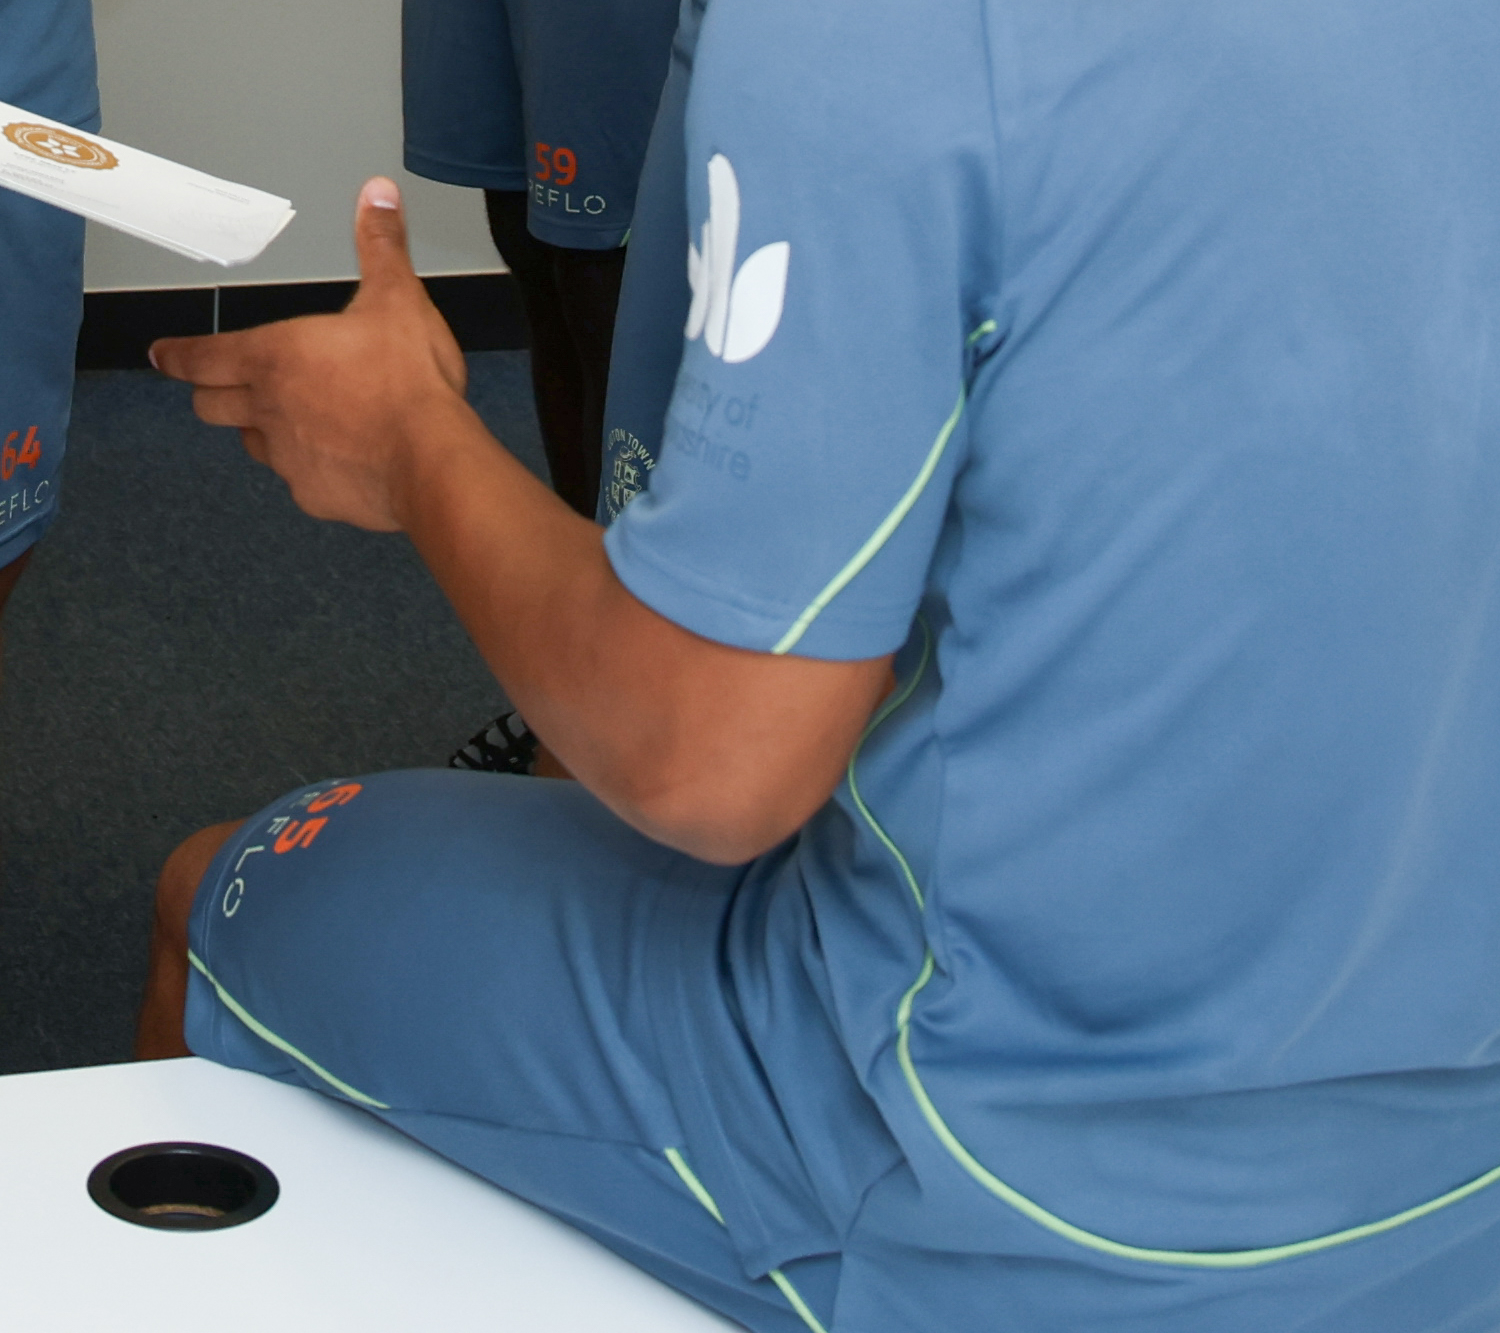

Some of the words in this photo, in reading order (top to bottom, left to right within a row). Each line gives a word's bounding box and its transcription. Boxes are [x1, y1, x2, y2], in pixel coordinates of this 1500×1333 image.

[535, 142, 578, 186] 59
[1, 425, 42, 481] 64
[628, 432, 656, 471] TOWN
[273, 783, 363, 854] 65
